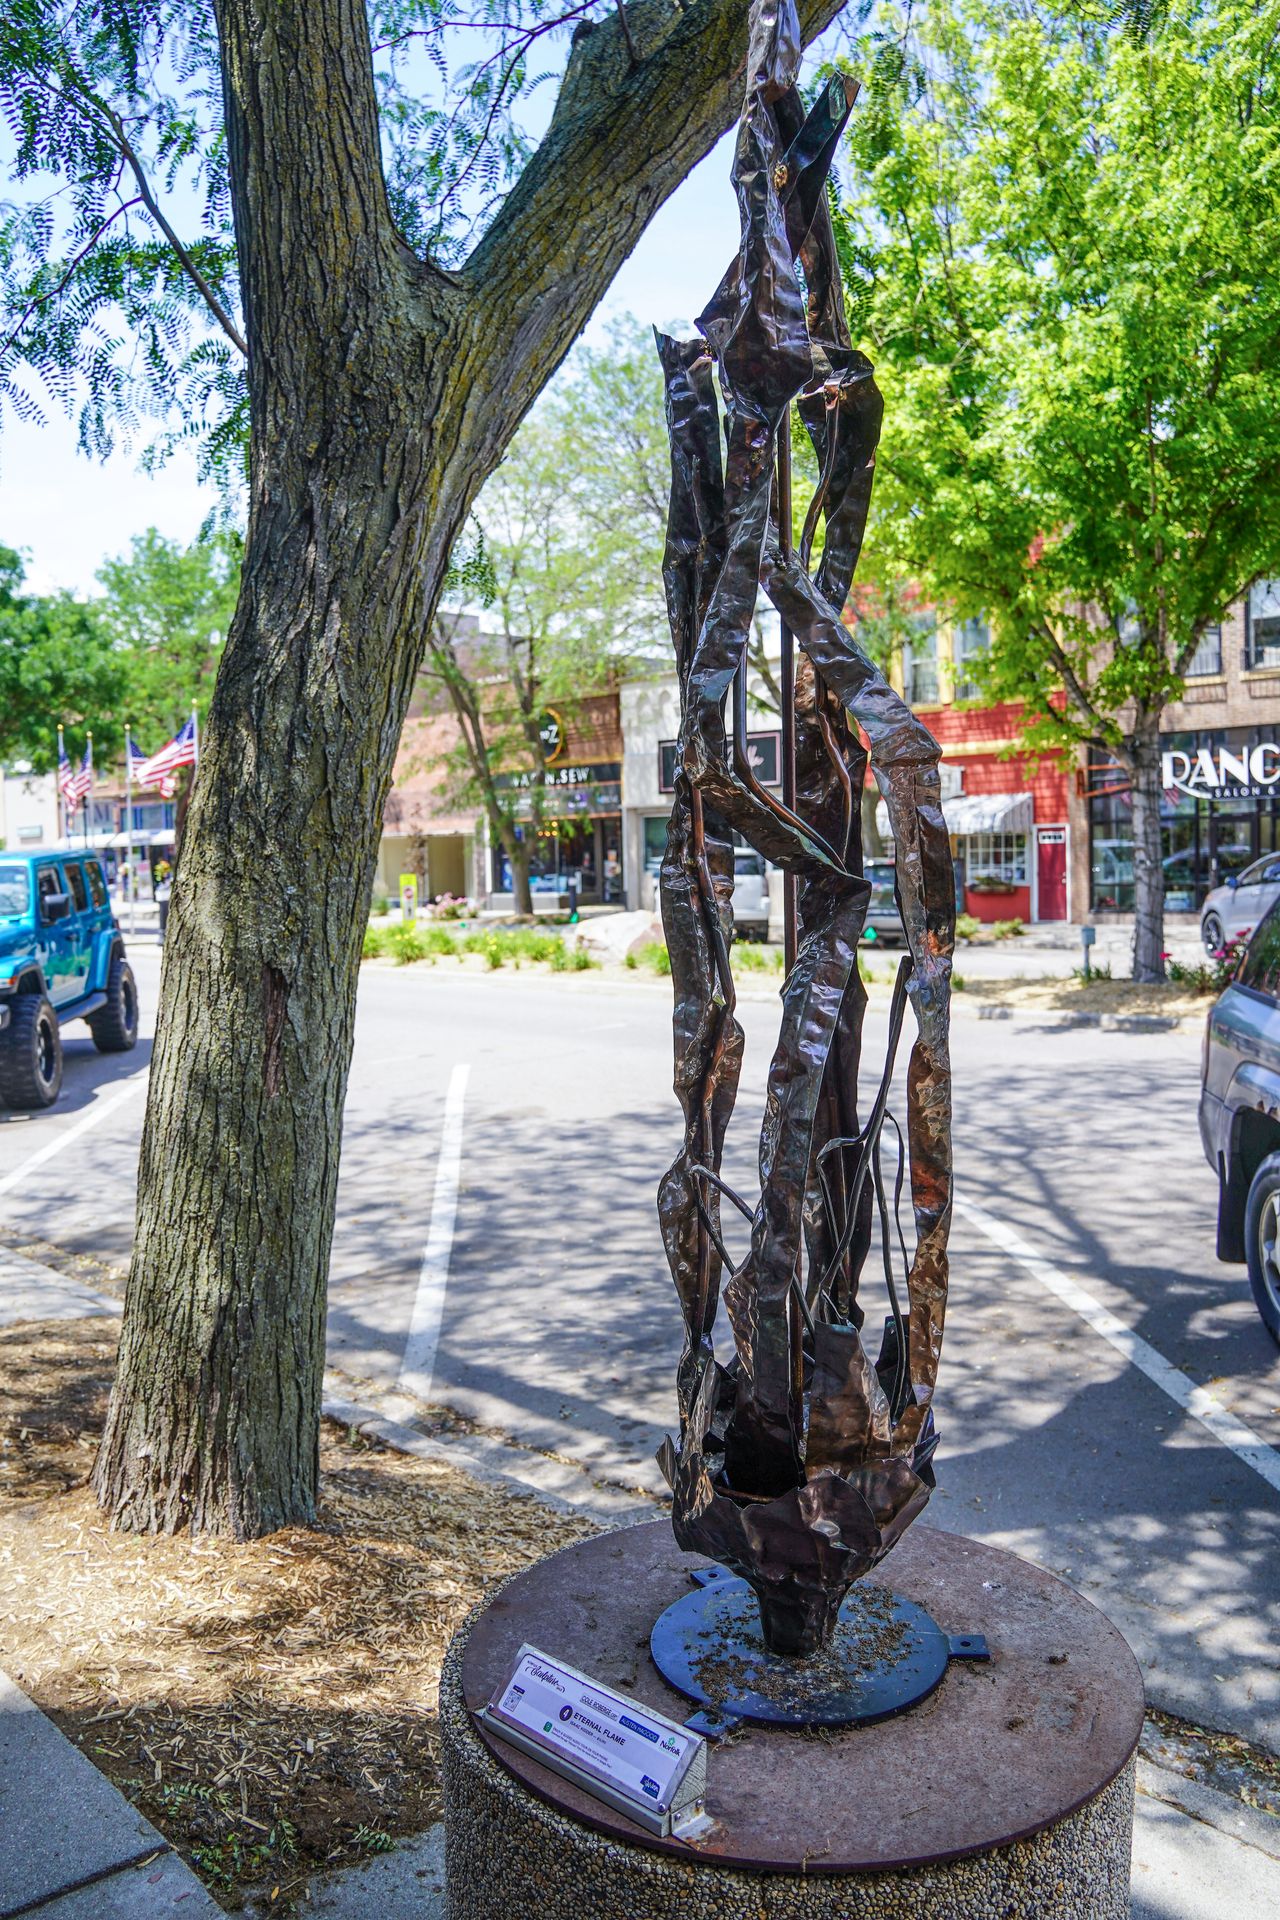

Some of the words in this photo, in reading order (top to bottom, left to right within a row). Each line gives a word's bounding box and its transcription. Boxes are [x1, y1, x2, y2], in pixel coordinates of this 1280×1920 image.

[1161, 743, 1280, 800] RANC
[1214, 786, 1261, 798] SALON
[573, 1712, 603, 1733] ETERNAL
[602, 1729, 627, 1747] FLAME
[660, 1740, 681, 1757] Norfolk
